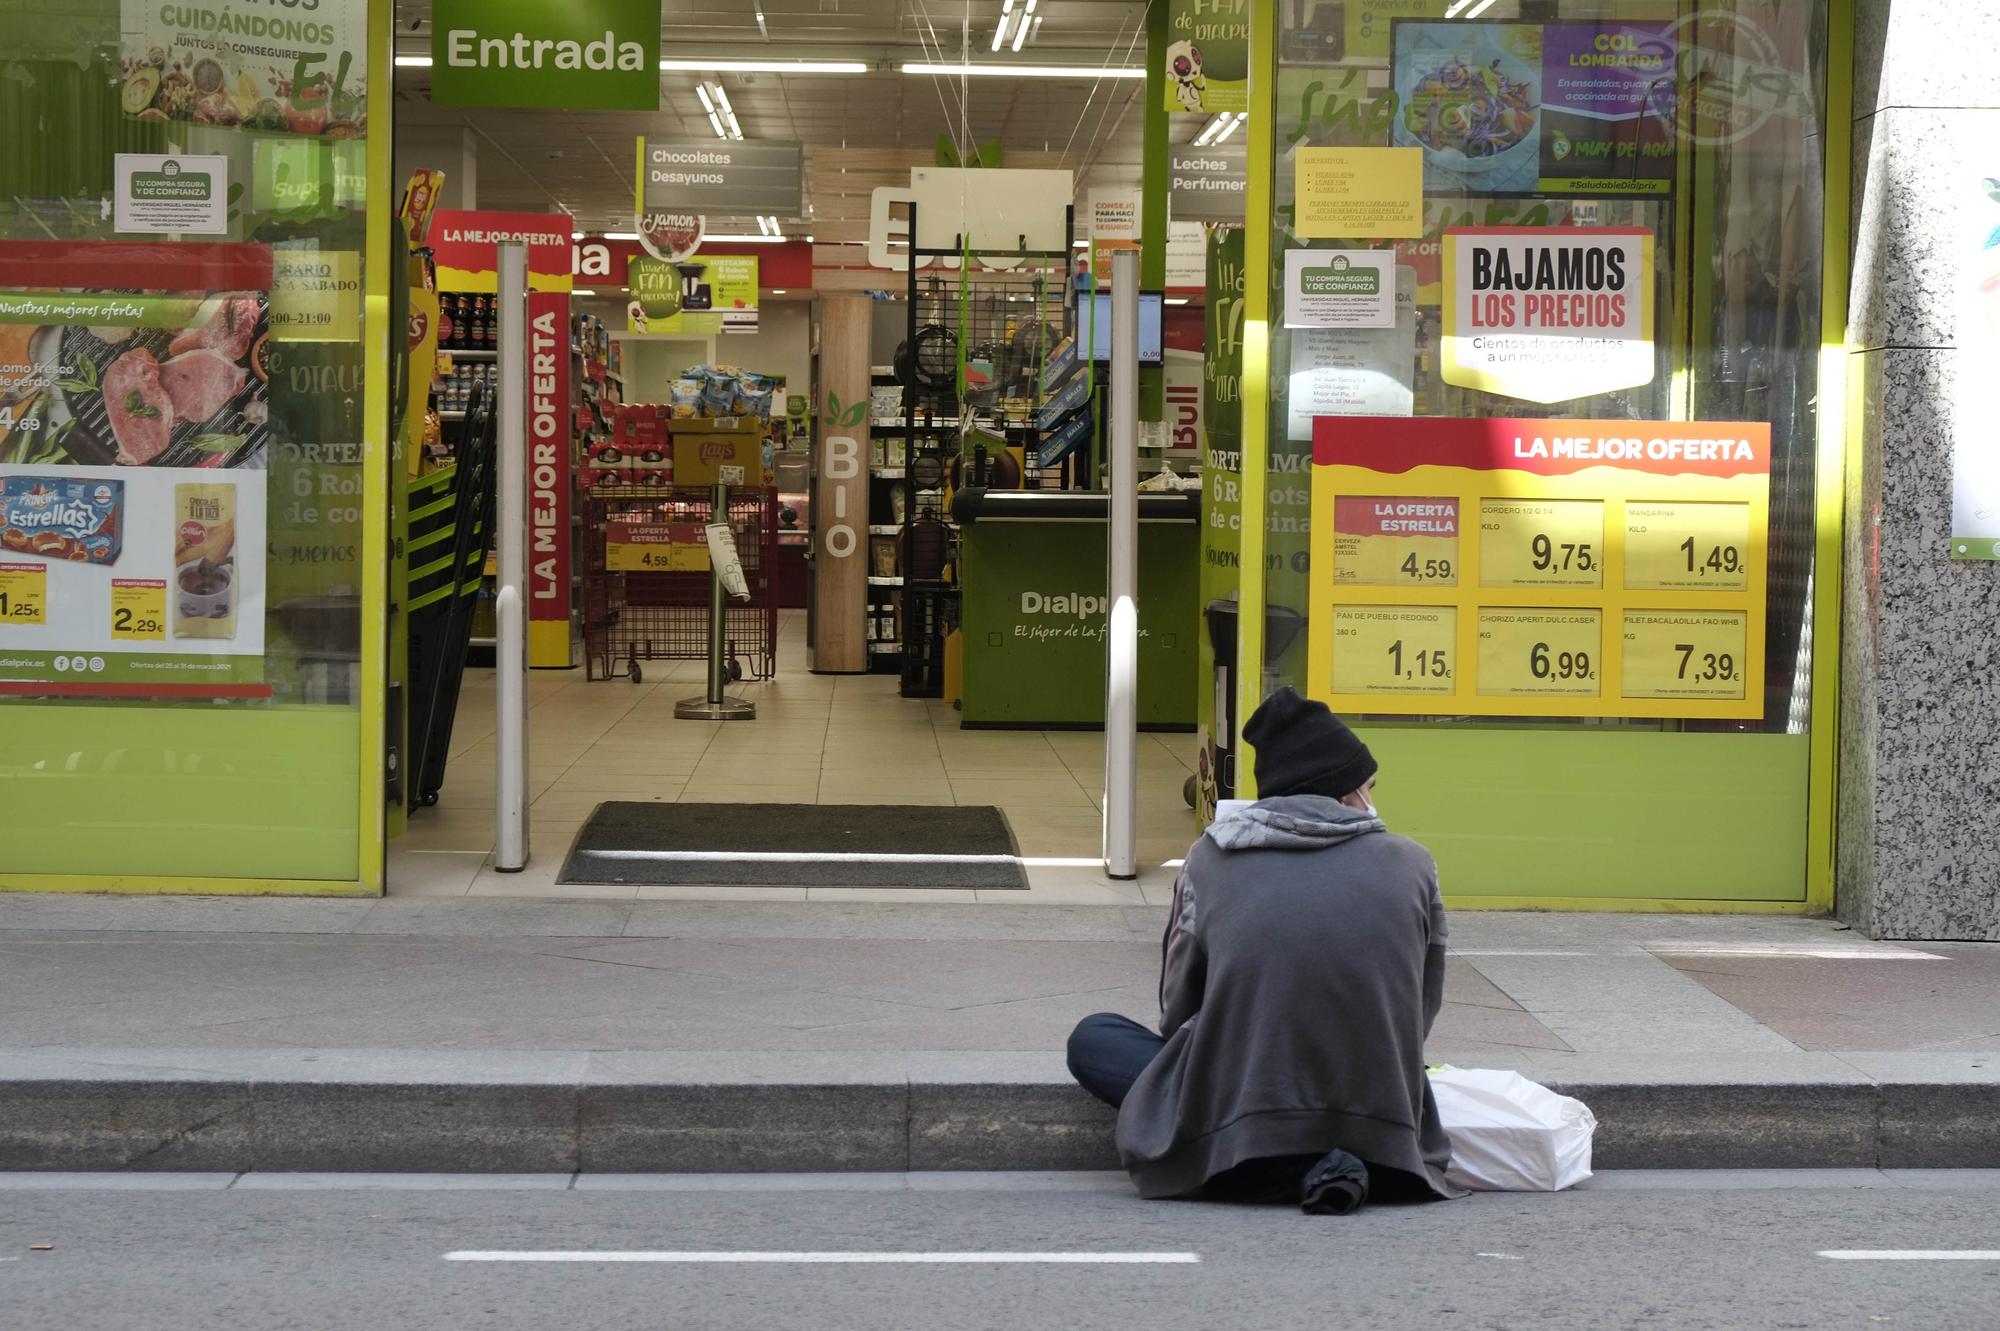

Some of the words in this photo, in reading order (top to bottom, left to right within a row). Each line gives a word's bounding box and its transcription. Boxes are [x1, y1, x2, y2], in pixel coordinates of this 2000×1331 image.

[159, 5, 335, 46] CUIDÁNDONOS
[1175, 11, 1193, 30] de
[1195, 24, 1250, 40] DIALPR
[231, 43, 303, 60] CONSEGUIRE
[448, 30, 645, 72] Entrada
[1594, 33, 1639, 51] COL
[1569, 54, 1664, 68] LOMBARDA
[1572, 92, 1617, 101] cocinada
[652, 150, 731, 165] Chocolates
[1575, 141, 1613, 158] MUY
[1616, 142, 1636, 157] DE
[1173, 158, 1228, 171] Leches
[651, 170, 725, 185] Desayunos
[1173, 178, 1247, 191] Perfumer
[1569, 181, 1657, 191] #SaludableDialprix
[156, 188, 206, 196] CONFIANZA
[443, 229, 461, 242] LA
[1472, 247, 1625, 291] BAJAMOS
[638, 273, 673, 290] FAN
[53, 303, 98, 319] mejores
[101, 303, 144, 317] ofertas
[1471, 294, 1516, 327] LOS
[1525, 294, 1625, 328] PRECIOS
[1216, 297, 1245, 358] FA
[1472, 337, 1526, 349] Cientos
[1487, 353, 1495, 362] a
[1499, 353, 1516, 362] un
[533, 311, 556, 438] OFERTA
[1166, 386, 1199, 450] Bull
[1514, 437, 1548, 458] LA
[1552, 438, 1642, 460] MEJOR
[1647, 439, 1754, 461] OFERTA
[534, 444, 557, 551] MEJOR
[1214, 474, 1222, 502] 6
[9, 503, 88, 528] Estrellas
[1210, 507, 1225, 529] de
[1375, 504, 1394, 516] LA
[1396, 504, 1455, 517] OFERTA
[1381, 519, 1455, 532] ESTRELLA
[1532, 534, 1597, 574] 9,75€
[1681, 536, 1744, 576] 1,49€
[534, 558, 557, 599] LA
[1022, 591, 1110, 620] Dialpr
[1064, 624, 1078, 637] de
[1388, 639, 1452, 680] 1,15€
[1530, 642, 1595, 682] 6,99€
[1675, 644, 1740, 684] 7,39€
